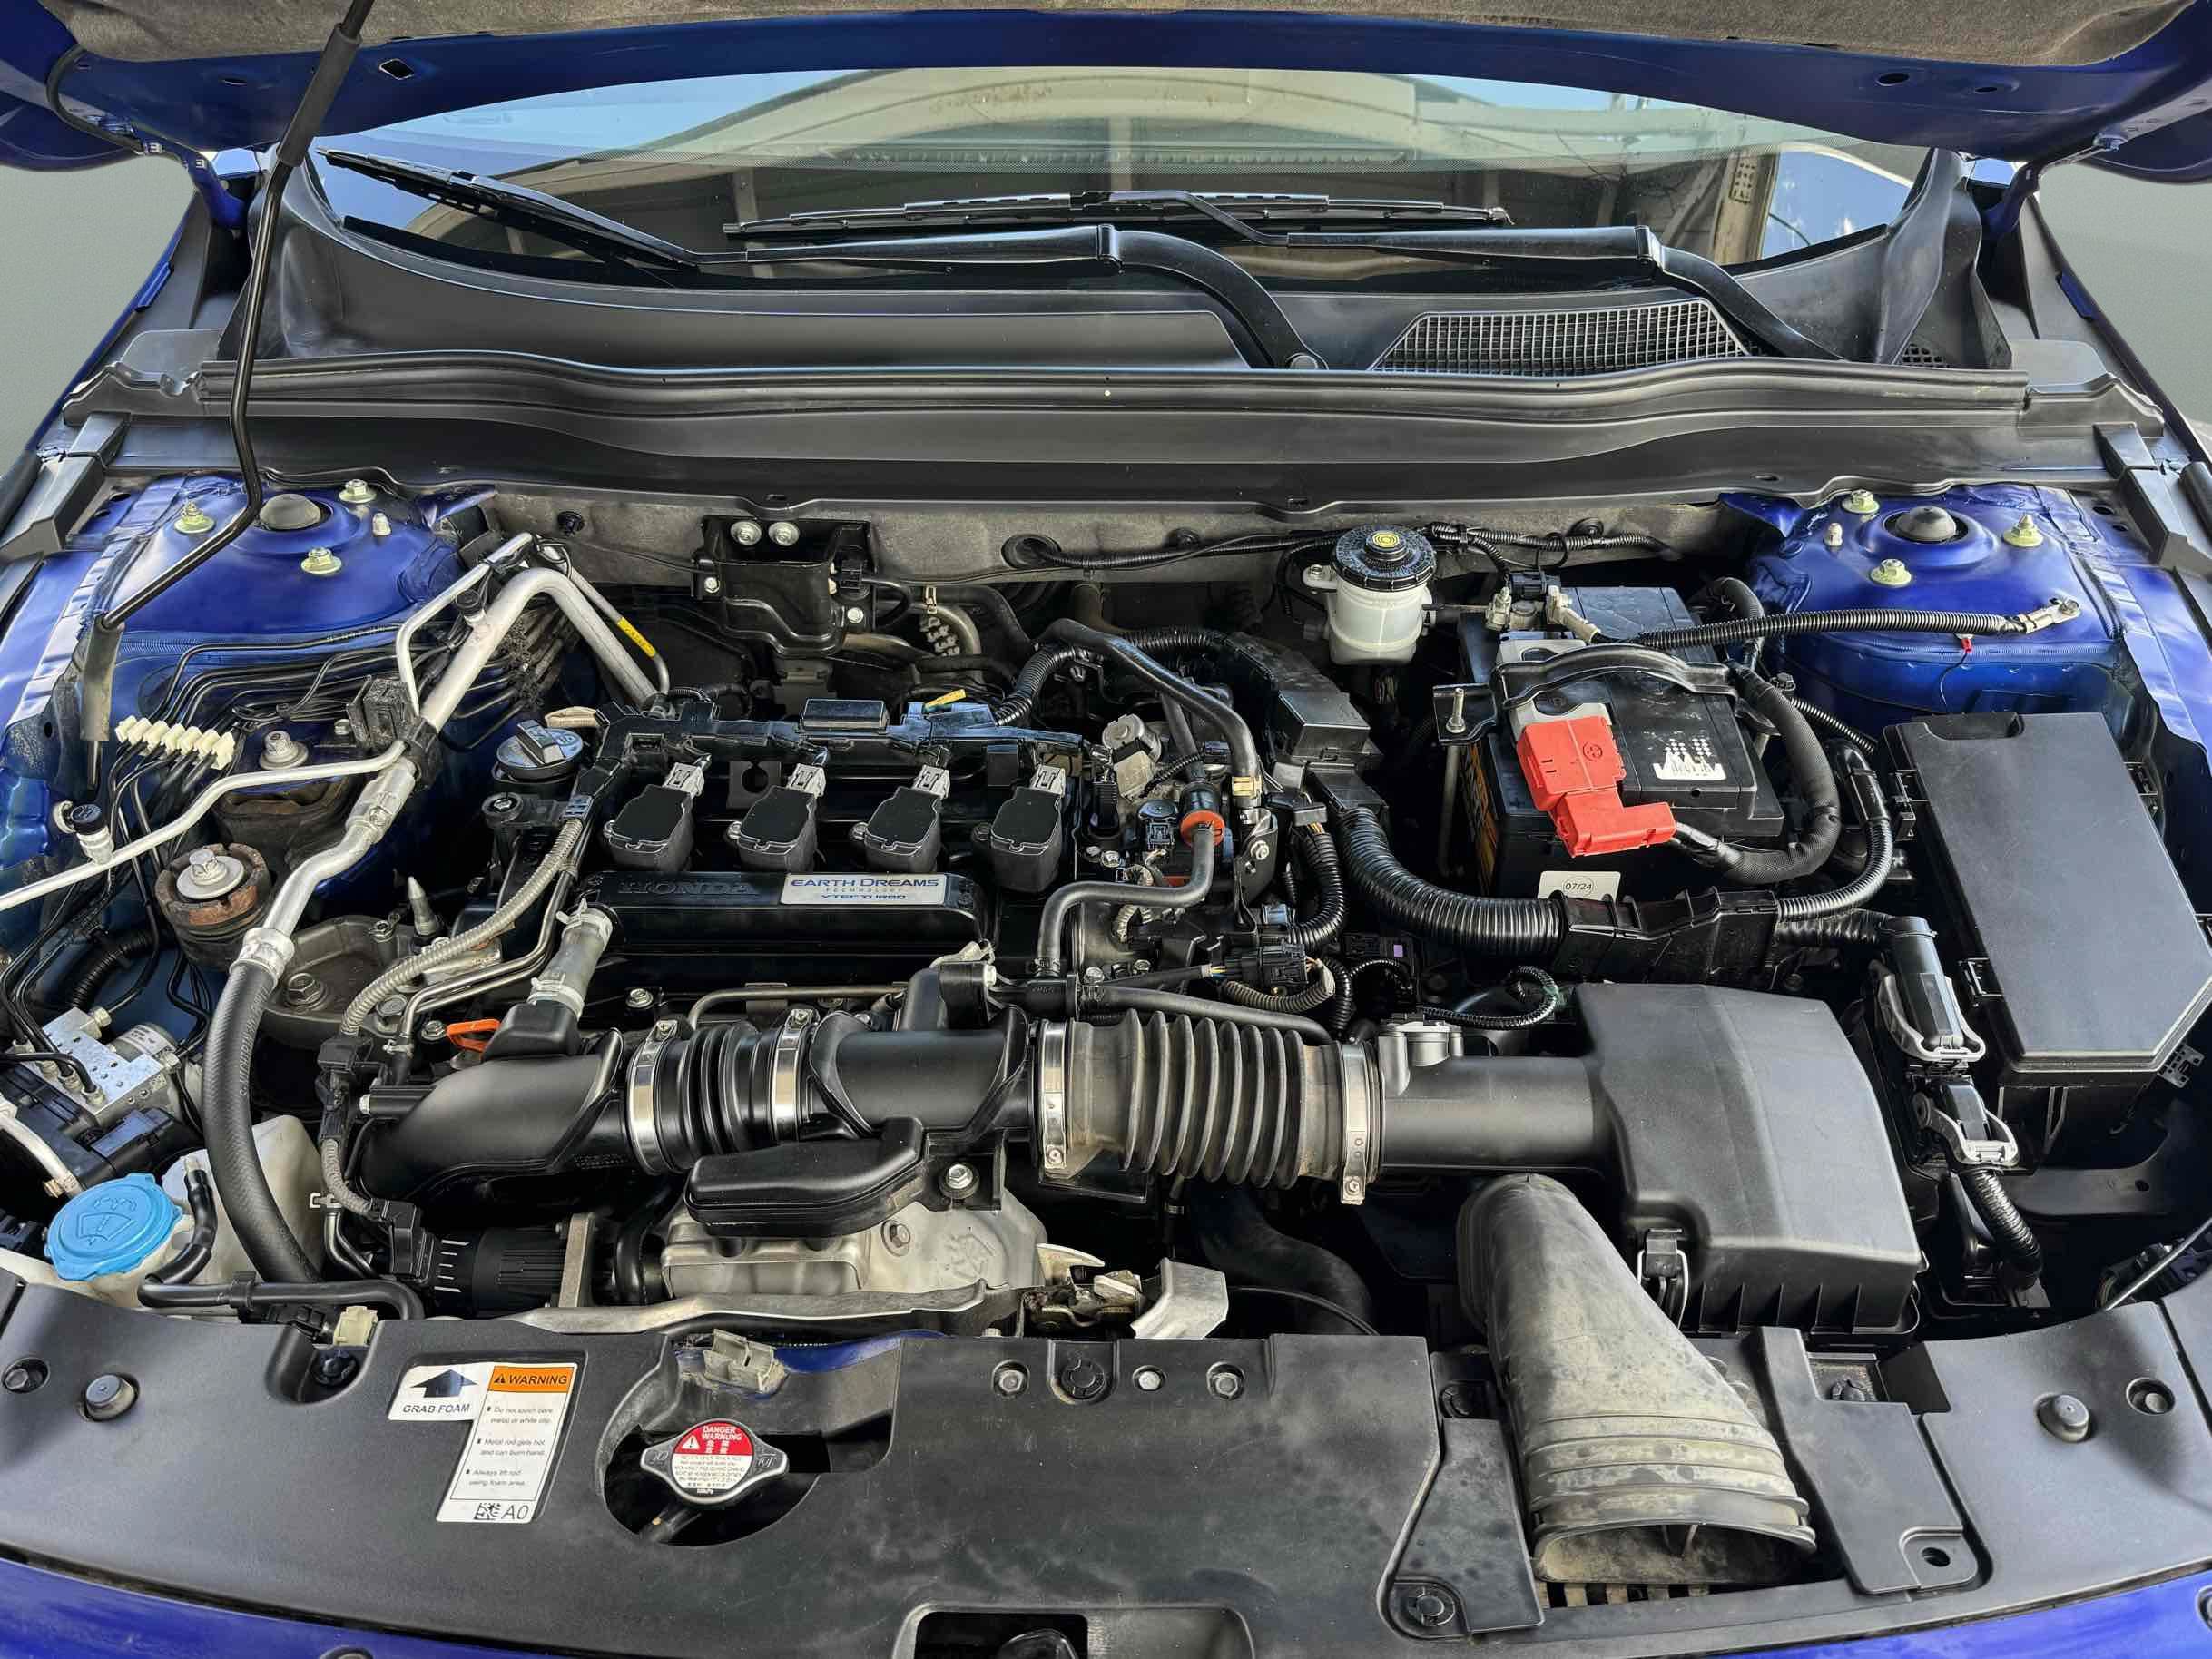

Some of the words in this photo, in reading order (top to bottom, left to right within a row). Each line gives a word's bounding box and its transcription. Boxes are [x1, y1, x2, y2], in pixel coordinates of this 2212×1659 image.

[860, 879, 939, 887] DREAMS
[509, 1374, 567, 1385] WARNING
[402, 1404, 436, 1413] GRAB
[437, 1403, 470, 1413] FOAM
[703, 1425, 736, 1433] DANGER
[501, 1504, 529, 1520] A0
